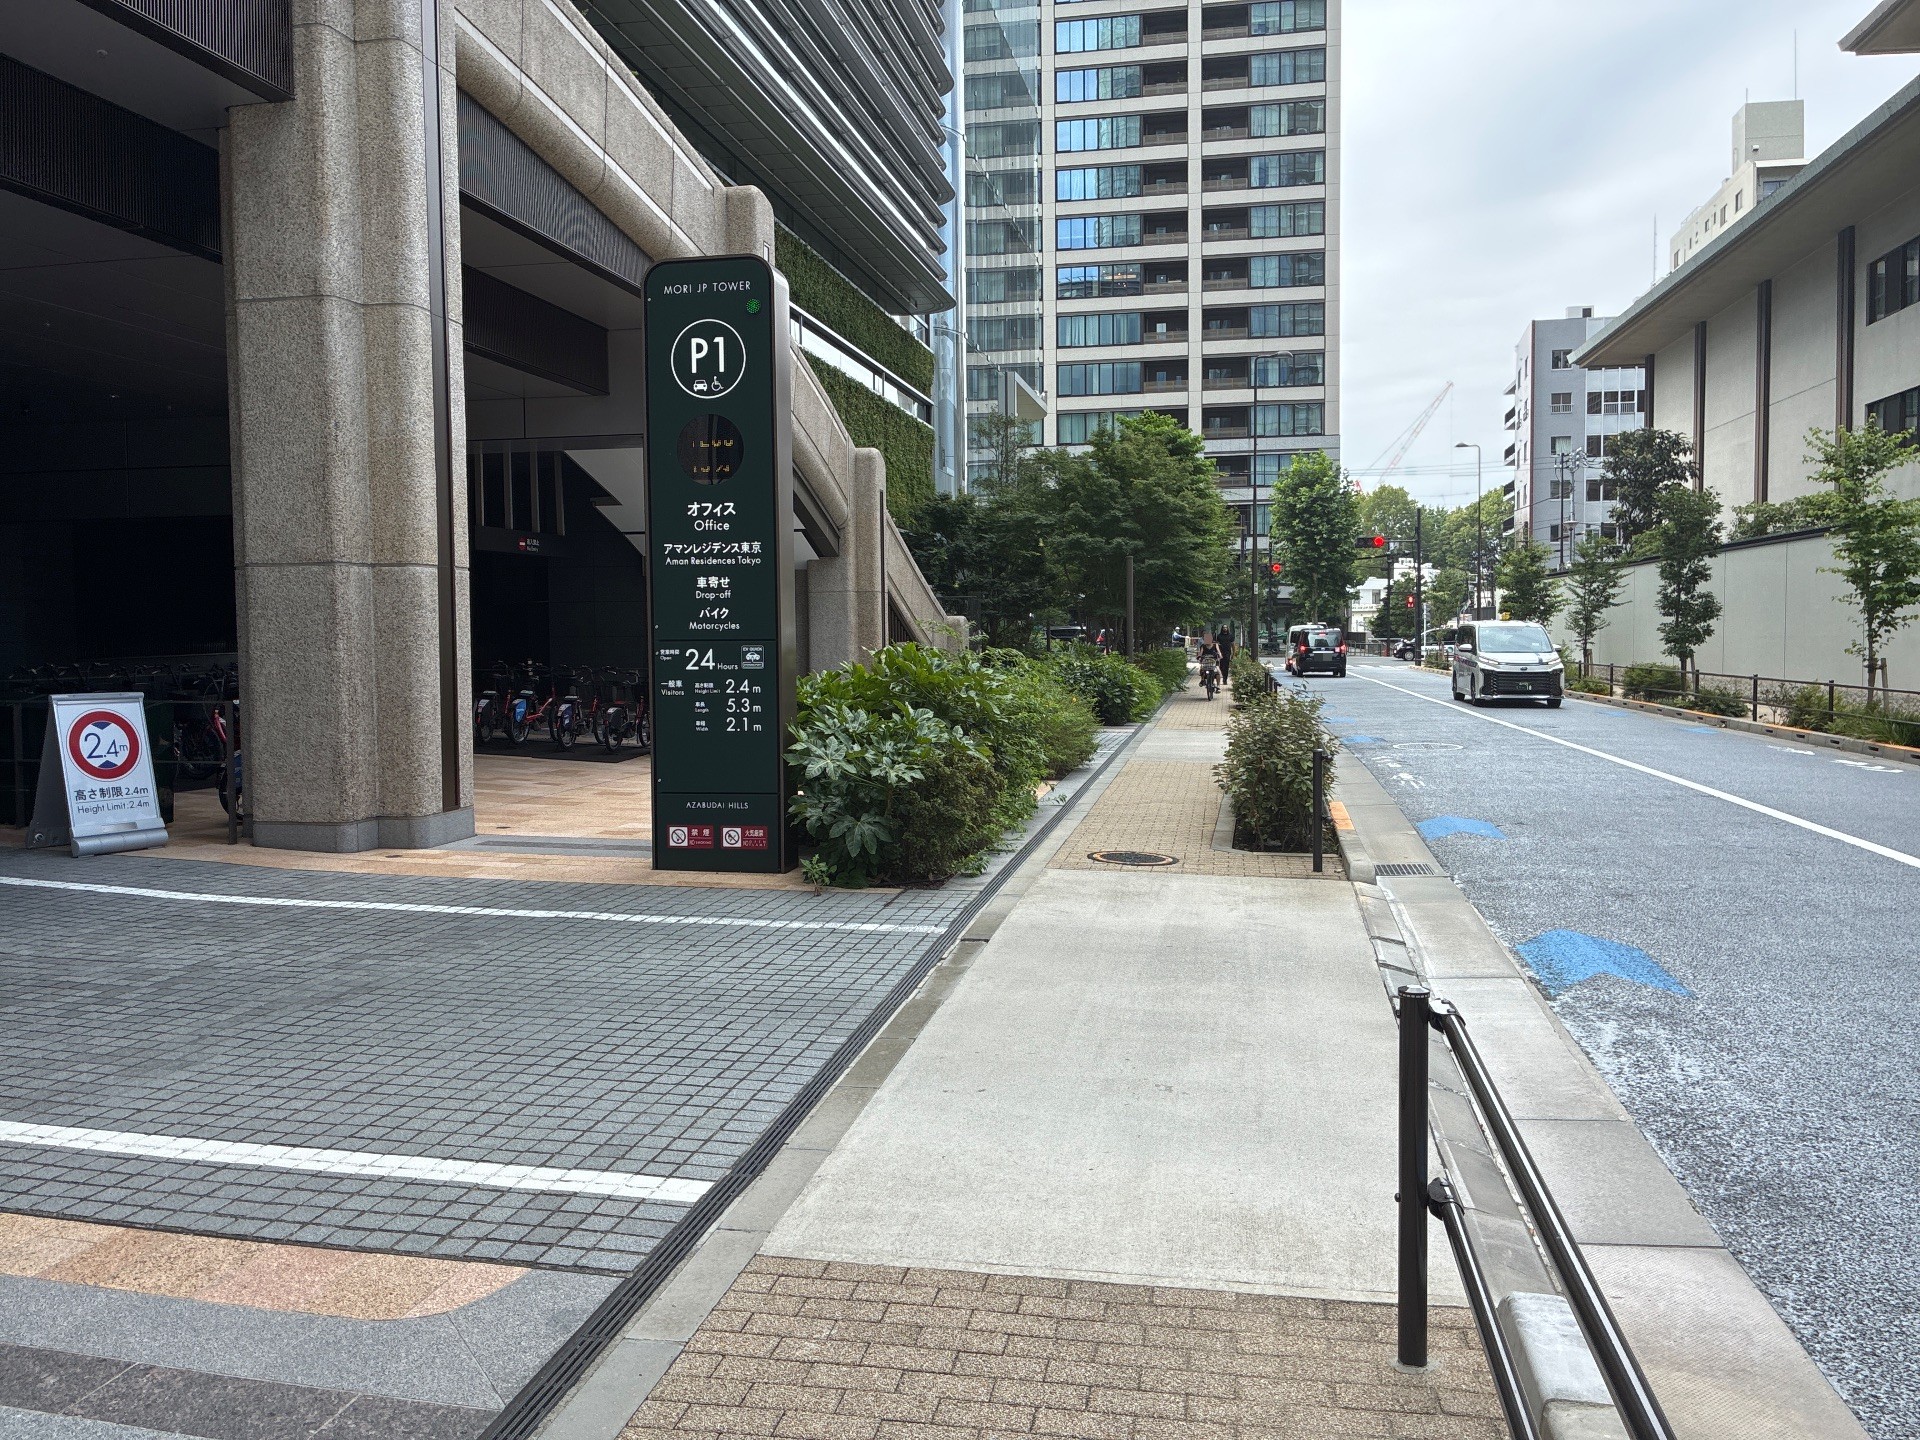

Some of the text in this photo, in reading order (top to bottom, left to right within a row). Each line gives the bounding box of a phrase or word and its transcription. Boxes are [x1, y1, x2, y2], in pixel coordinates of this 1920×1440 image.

[664, 280, 751, 295] MORI JP TOWER
[690, 336, 725, 374] P1
[687, 501, 737, 517] オフィス
[694, 518, 730, 531] Office
[664, 541, 762, 555] アマンレジデンス東京
[666, 555, 762, 567] Aman Residences Tokyo
[697, 575, 731, 589] 車寄せ
[696, 589, 732, 601] Drop-off
[700, 606, 730, 620] バイク
[689, 621, 740, 632] Motorcycles
[685, 648, 739, 671] 24 Hours
[661, 679, 683, 688] 一般車
[725, 678, 762, 694] 2.4 m
[660, 688, 685, 696] Visitors
[725, 697, 762, 713] 5.3 m
[726, 716, 762, 732] 2.1 m
[84, 732, 128, 760] 2.4m
[74, 786, 149, 801] 高さ制限 2.4m
[77, 803, 105, 814] Height
[686, 801, 749, 810] AZABUDAI HILLS
